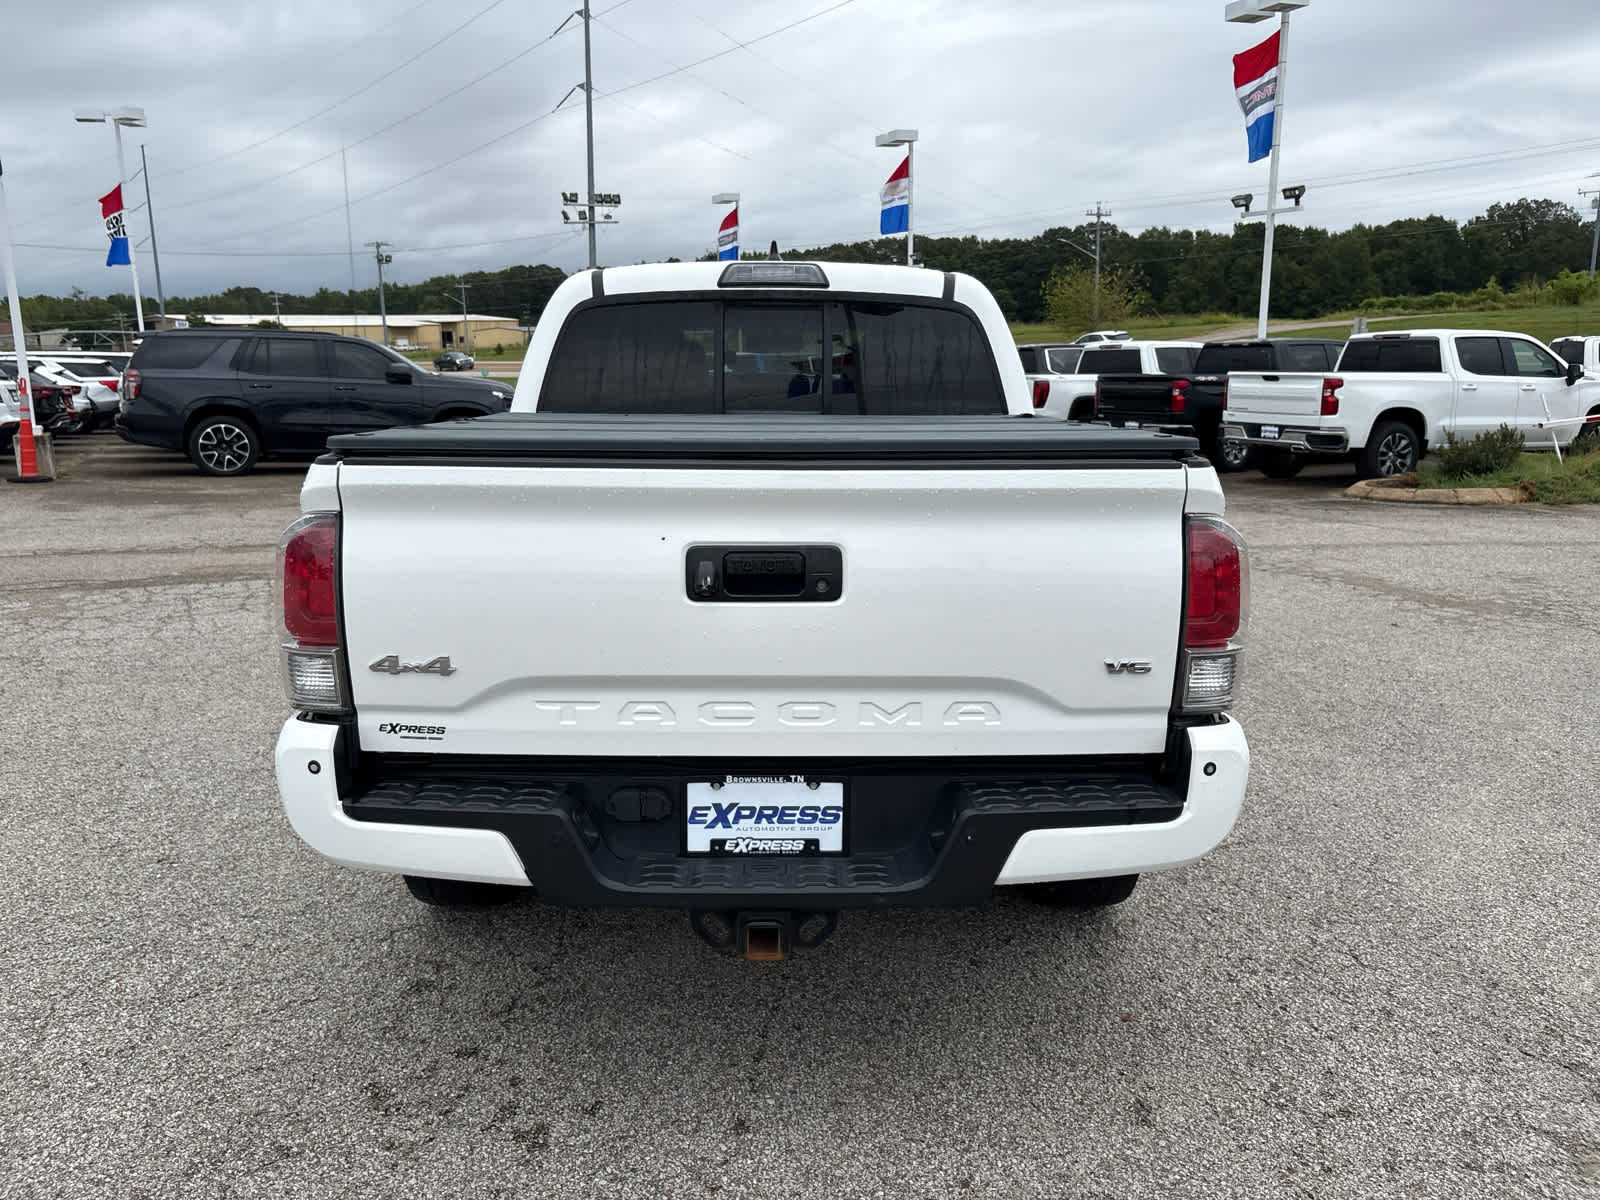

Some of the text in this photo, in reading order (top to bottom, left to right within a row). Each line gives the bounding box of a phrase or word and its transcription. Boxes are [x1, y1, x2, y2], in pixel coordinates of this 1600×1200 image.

[1103, 658, 1152, 674] V6
[535, 700, 1001, 727] TACOMA
[379, 722, 446, 735] EXPRESS
[790, 775, 805, 783] TN
[688, 803, 843, 829] EXPRESS
[724, 838, 805, 853] EXPRESS
